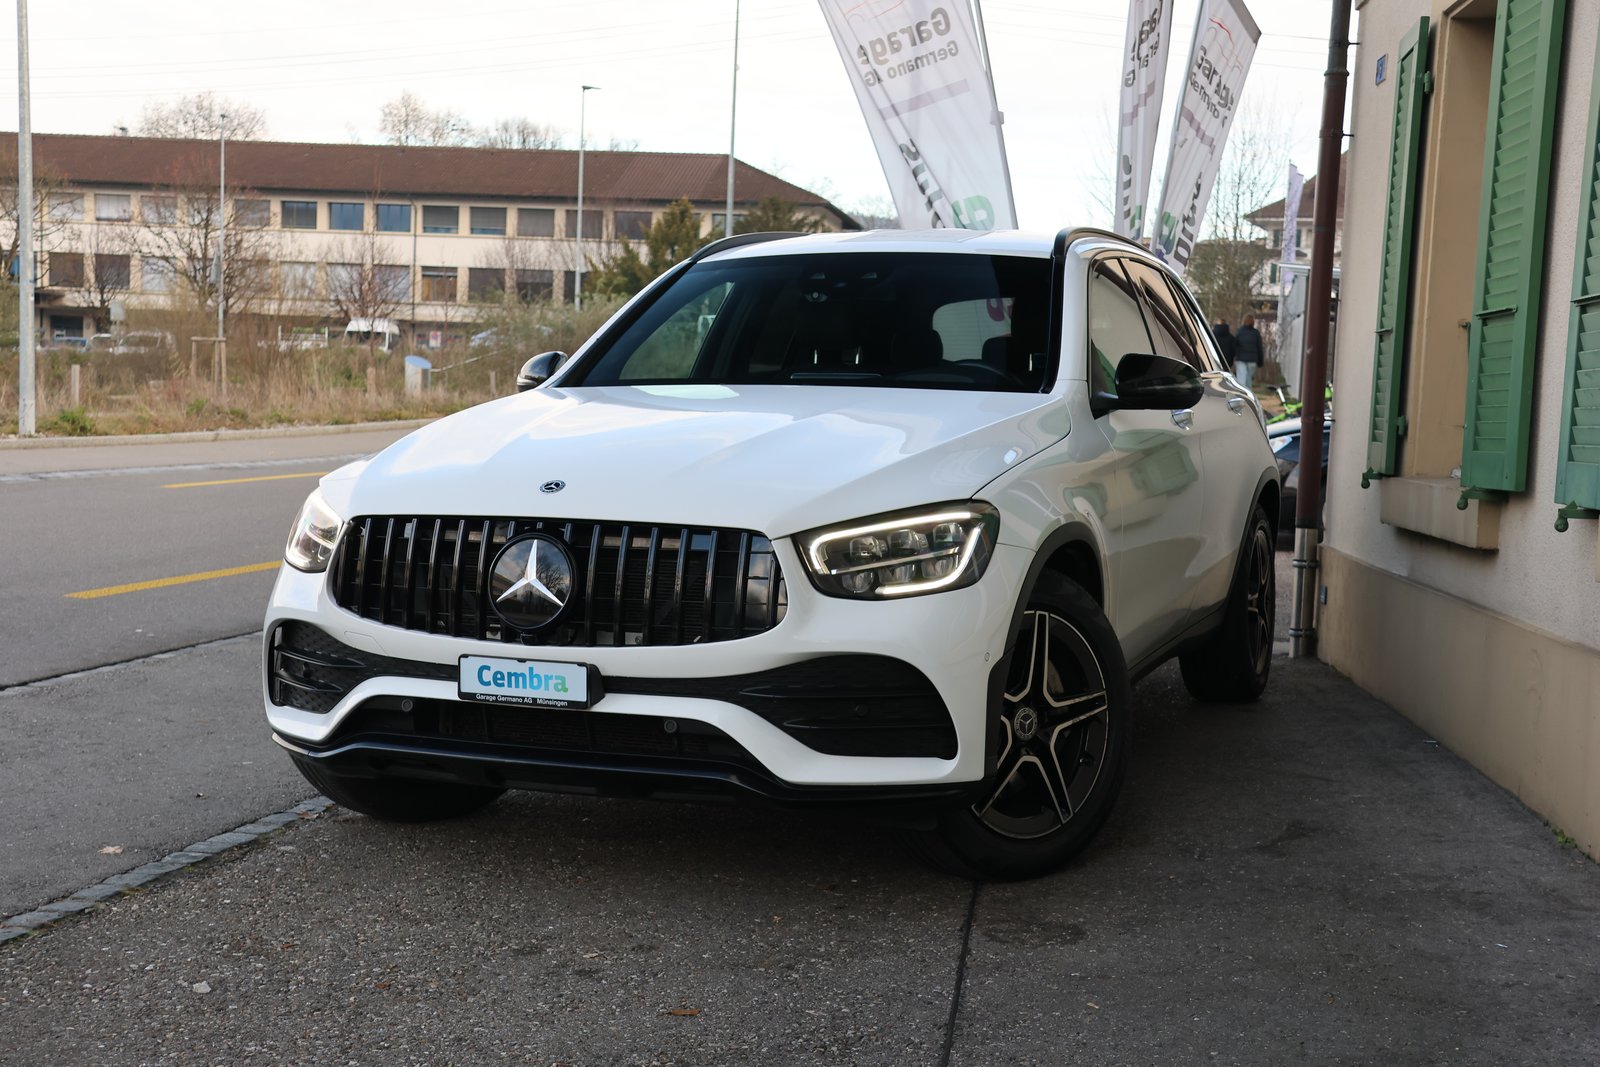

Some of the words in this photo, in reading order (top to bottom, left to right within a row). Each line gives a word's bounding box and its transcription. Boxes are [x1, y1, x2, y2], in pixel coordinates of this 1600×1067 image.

[477, 665, 568, 693] Cembra
[476, 693, 497, 701] Garage
[497, 695, 523, 704] Germano
[536, 698, 568, 707] Münsingen
